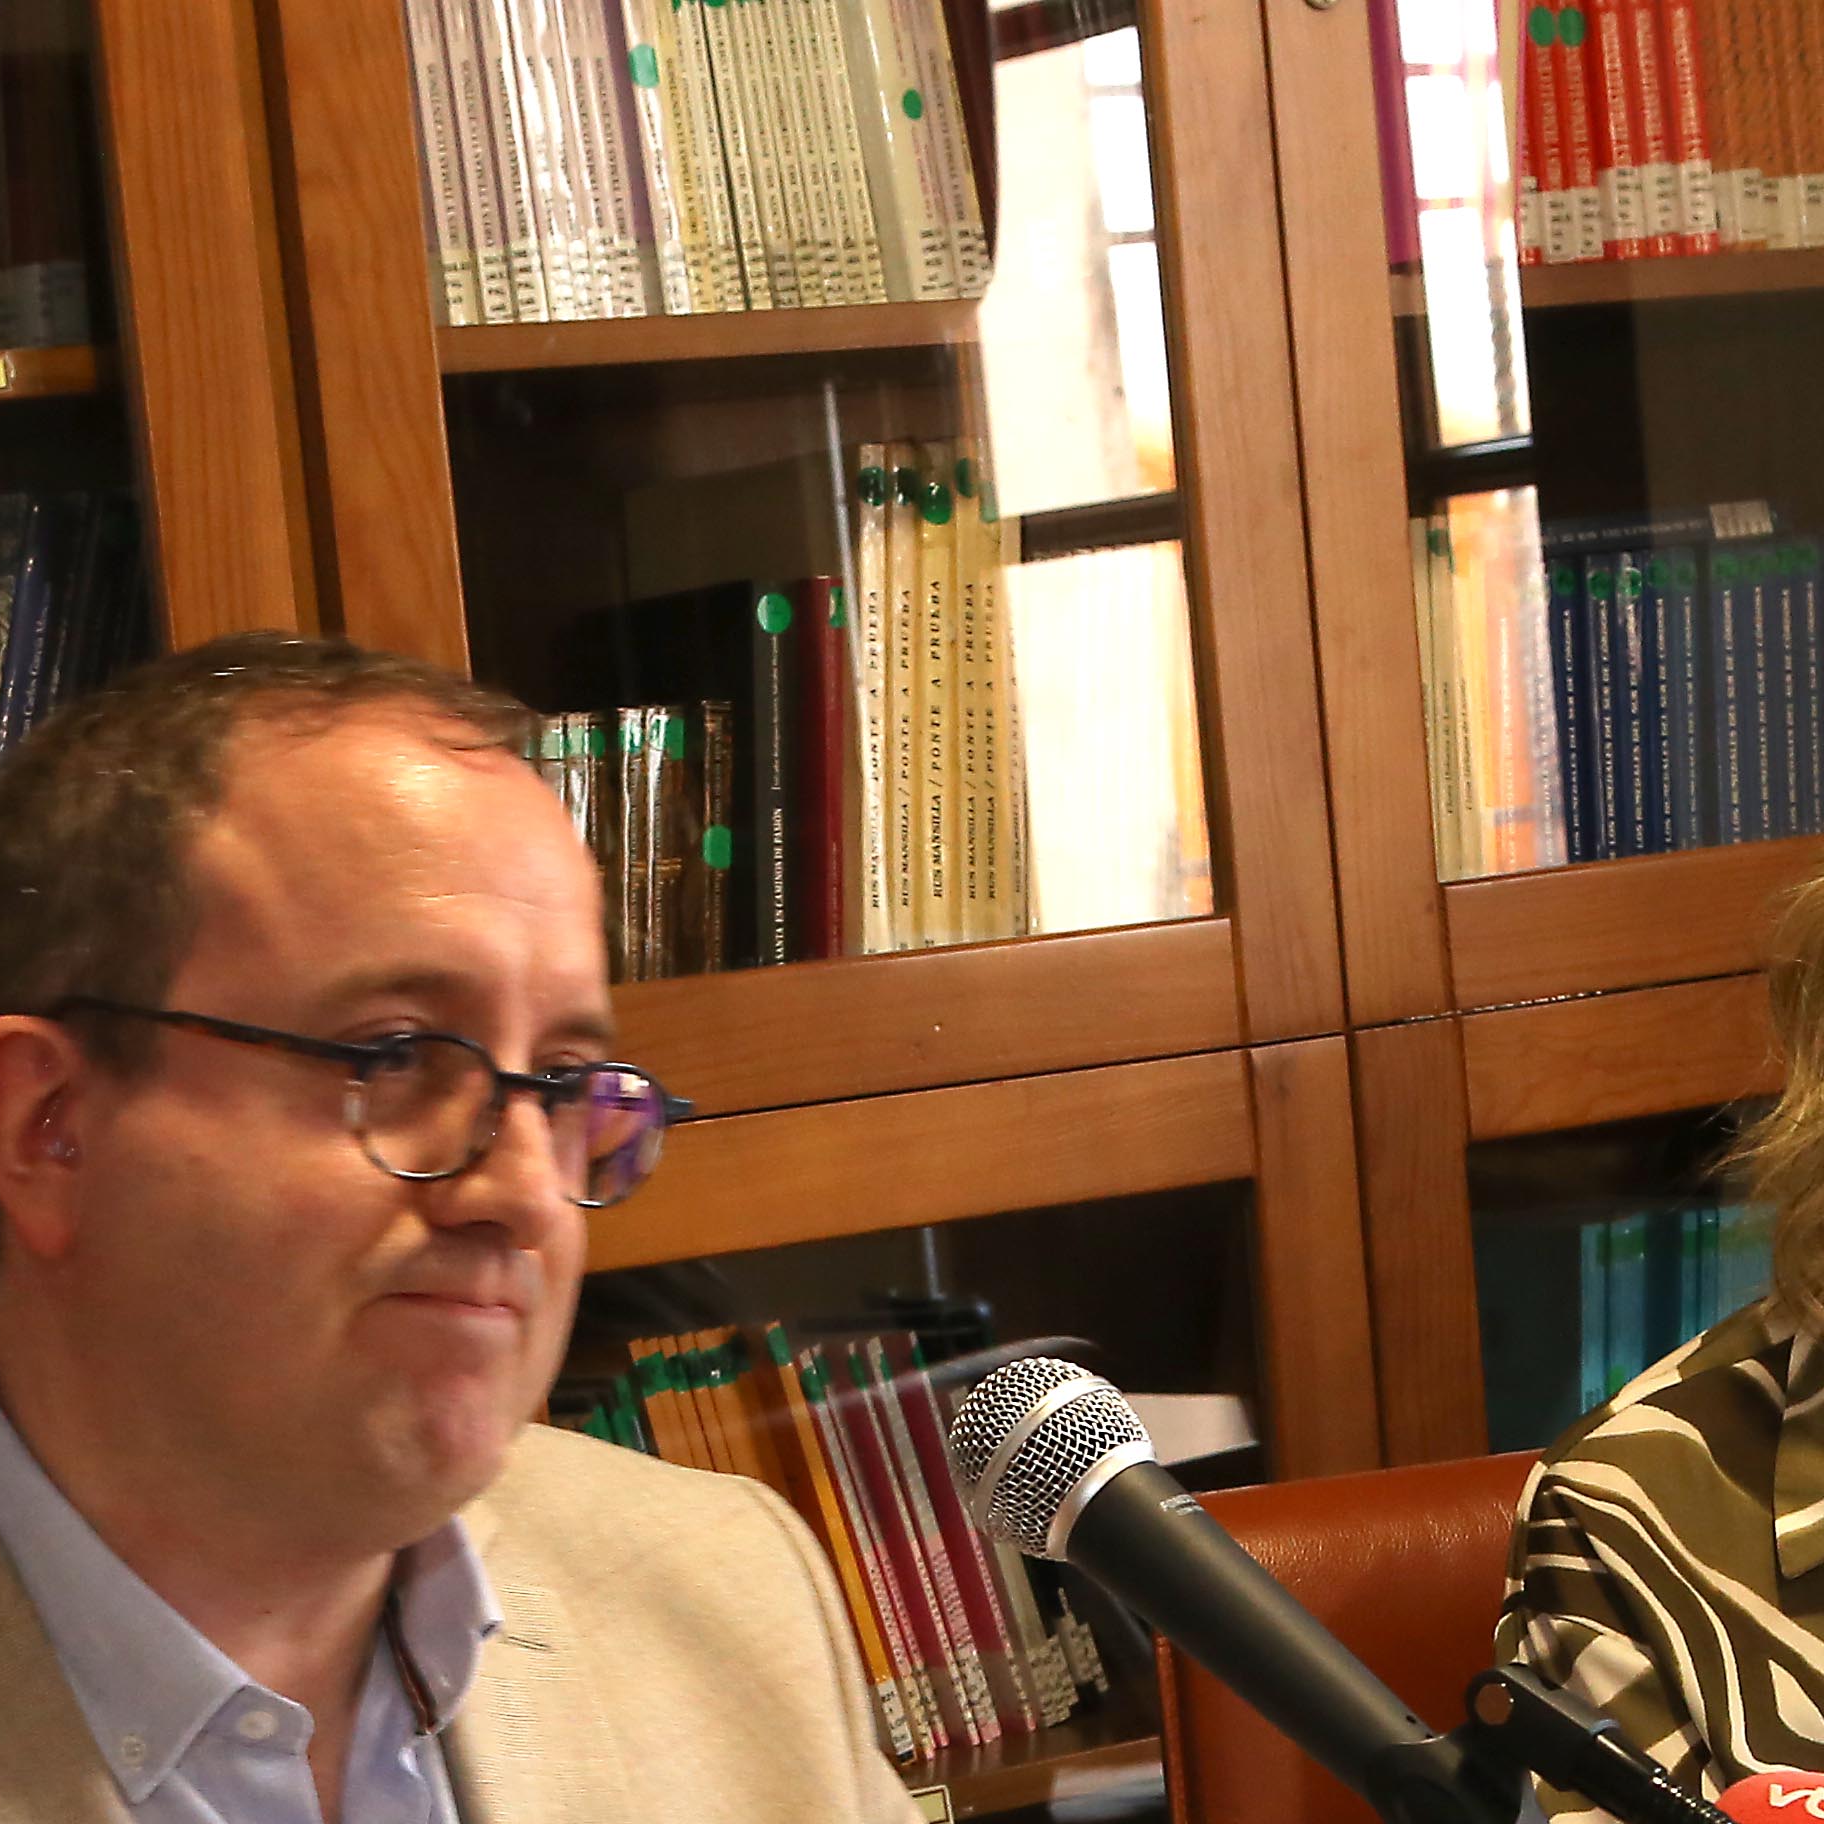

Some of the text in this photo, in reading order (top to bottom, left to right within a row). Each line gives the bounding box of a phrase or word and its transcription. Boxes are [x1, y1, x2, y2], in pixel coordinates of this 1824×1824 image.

[929, 579, 942, 897] RUS MANSILLA PONTE A PRUEBA
